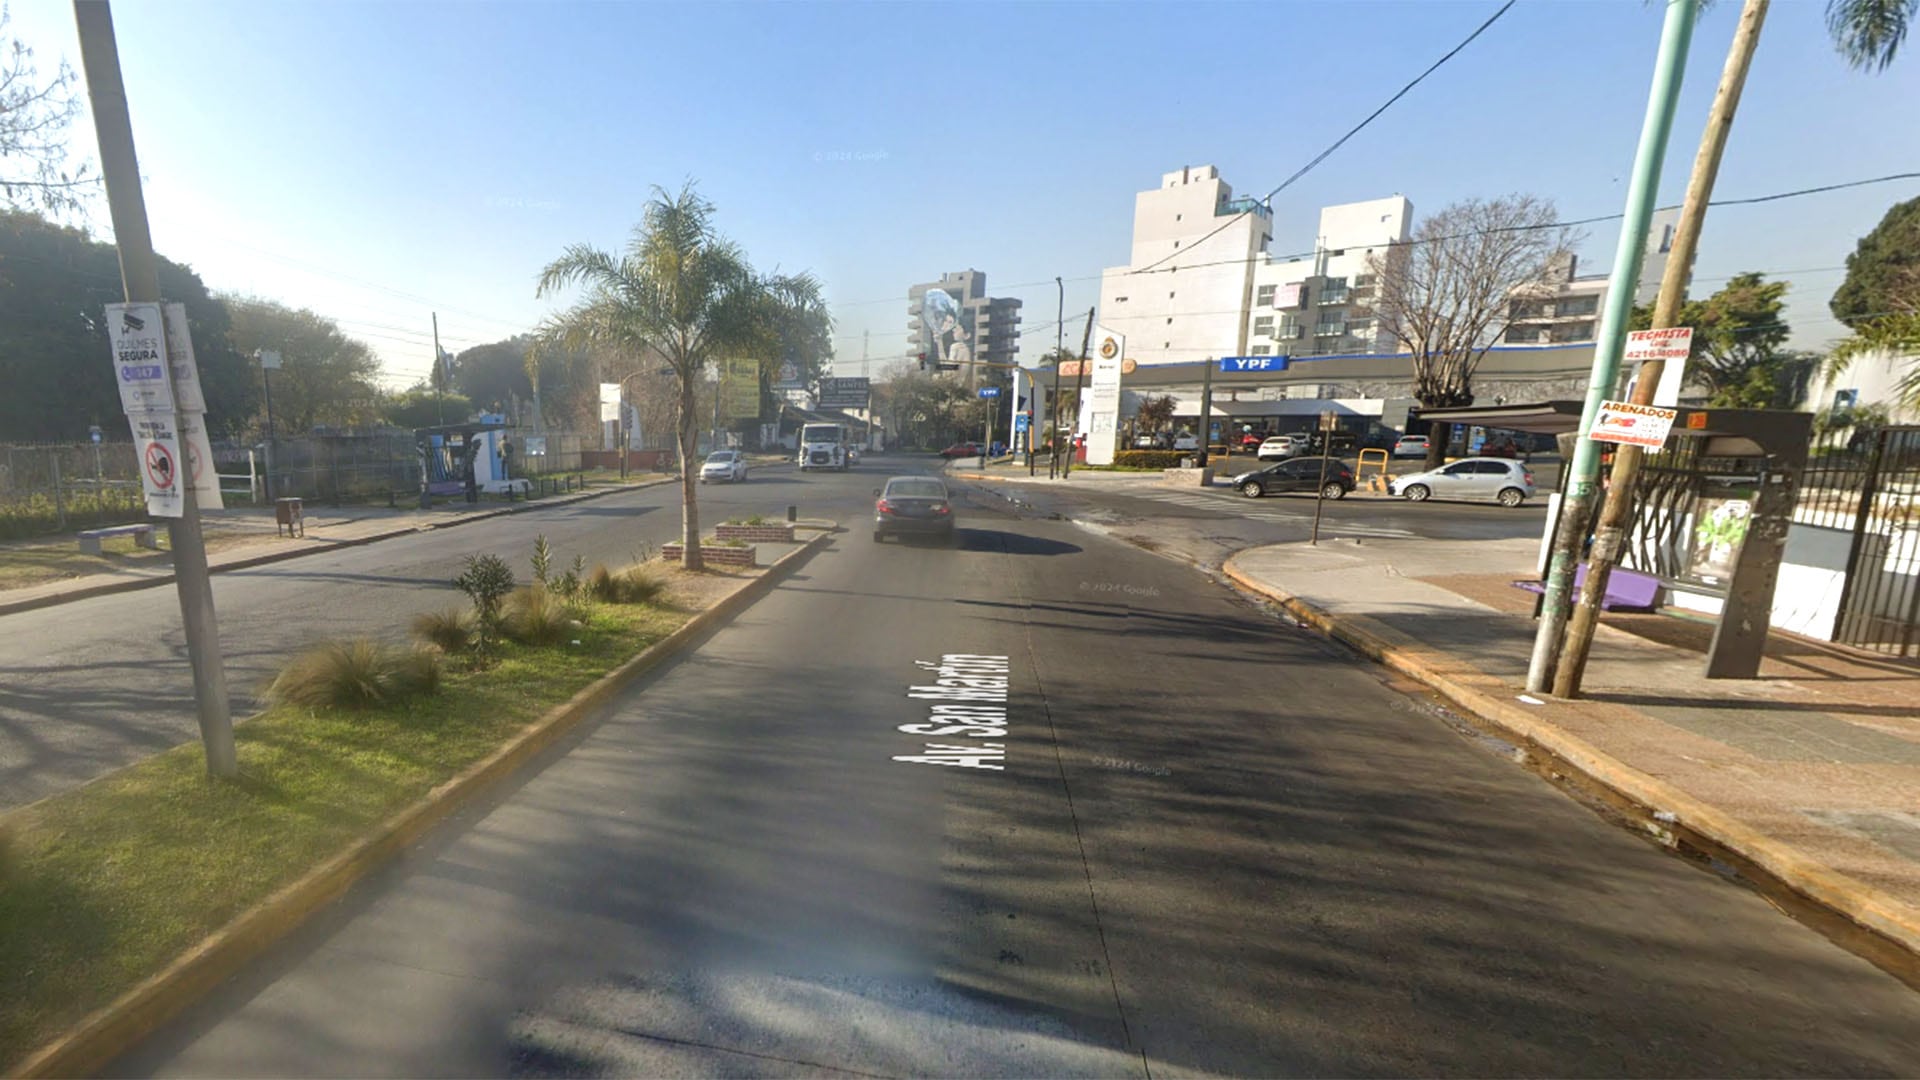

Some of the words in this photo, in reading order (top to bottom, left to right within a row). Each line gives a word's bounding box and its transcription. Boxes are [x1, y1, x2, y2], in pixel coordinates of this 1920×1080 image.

[1631, 328, 1690, 342] TECHISTA
[117, 338, 158, 350] QUILMES
[118, 349, 159, 361] SEGURA
[1235, 359, 1272, 369] YPF
[1602, 402, 1675, 420] ARENADOS
